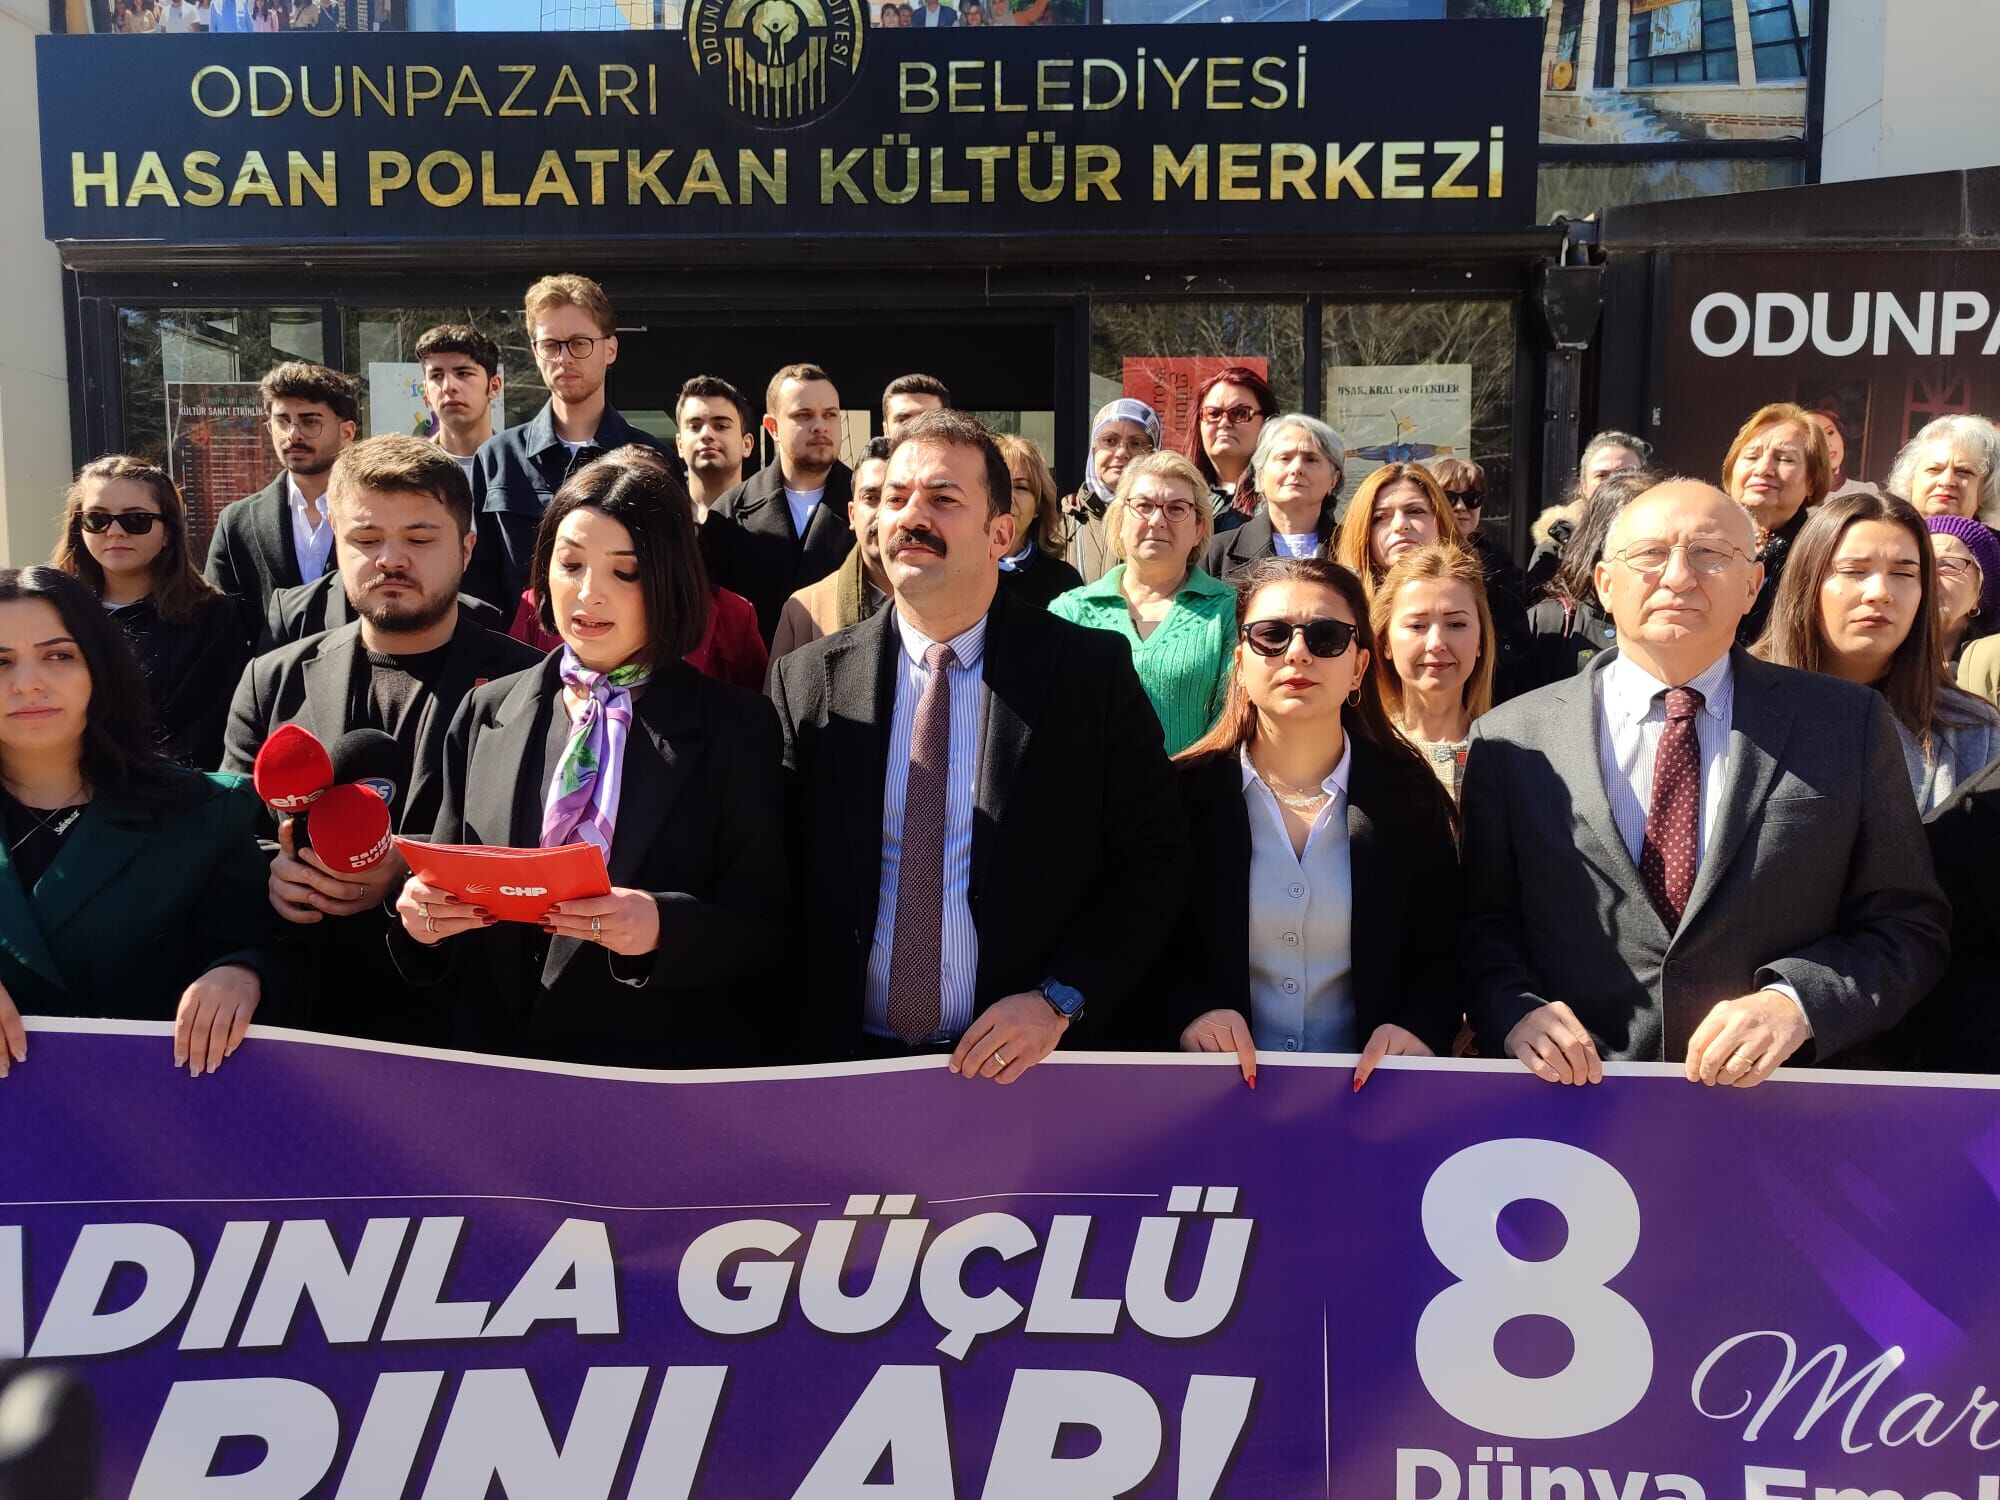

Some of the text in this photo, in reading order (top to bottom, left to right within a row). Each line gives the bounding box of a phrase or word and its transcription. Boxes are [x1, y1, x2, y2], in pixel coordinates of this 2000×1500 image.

[190, 45, 1307, 118] ODUNPAZARI BELEDİYESİ
[71, 125, 1504, 208] HASAN POLATKAN KÜLTÜR MERKEZİ
[1690, 291, 2000, 358] ODUNP
[498, 885, 548, 897] CHP
[0, 1185, 1254, 1361] DINLA GÜÇLÜ
[1415, 1137, 1654, 1440] 8
